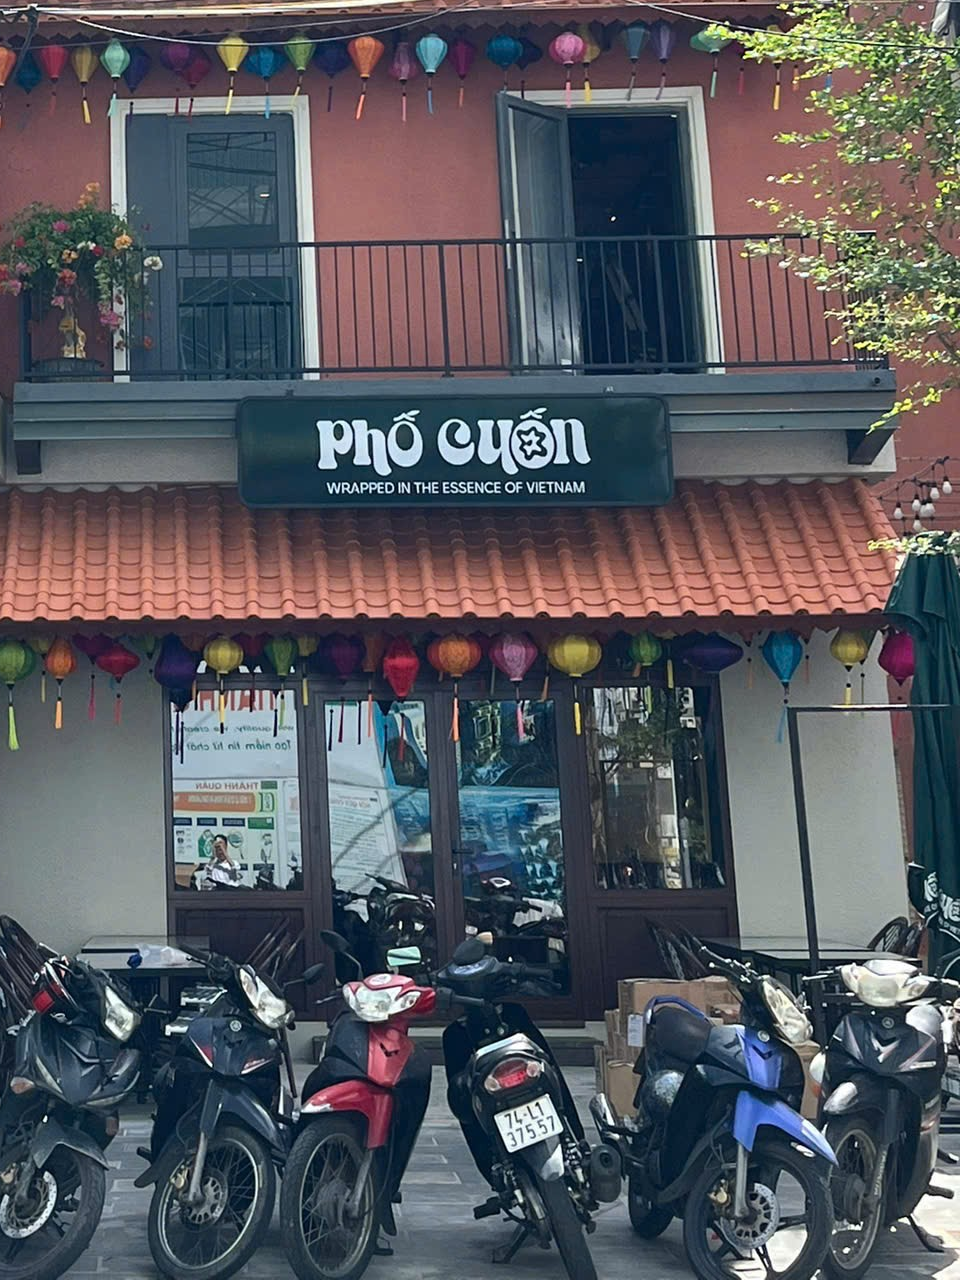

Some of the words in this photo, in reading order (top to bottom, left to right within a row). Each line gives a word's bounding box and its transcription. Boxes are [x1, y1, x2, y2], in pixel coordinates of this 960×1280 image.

[327, 482, 395, 495] WRAPPED
[398, 482, 411, 495] IN
[413, 482, 439, 494] THE
[442, 481, 501, 494] ESSENCE
[504, 481, 522, 494] OF
[524, 481, 586, 494] VIETNAM
[504, 1101, 545, 1129] 74-L1
